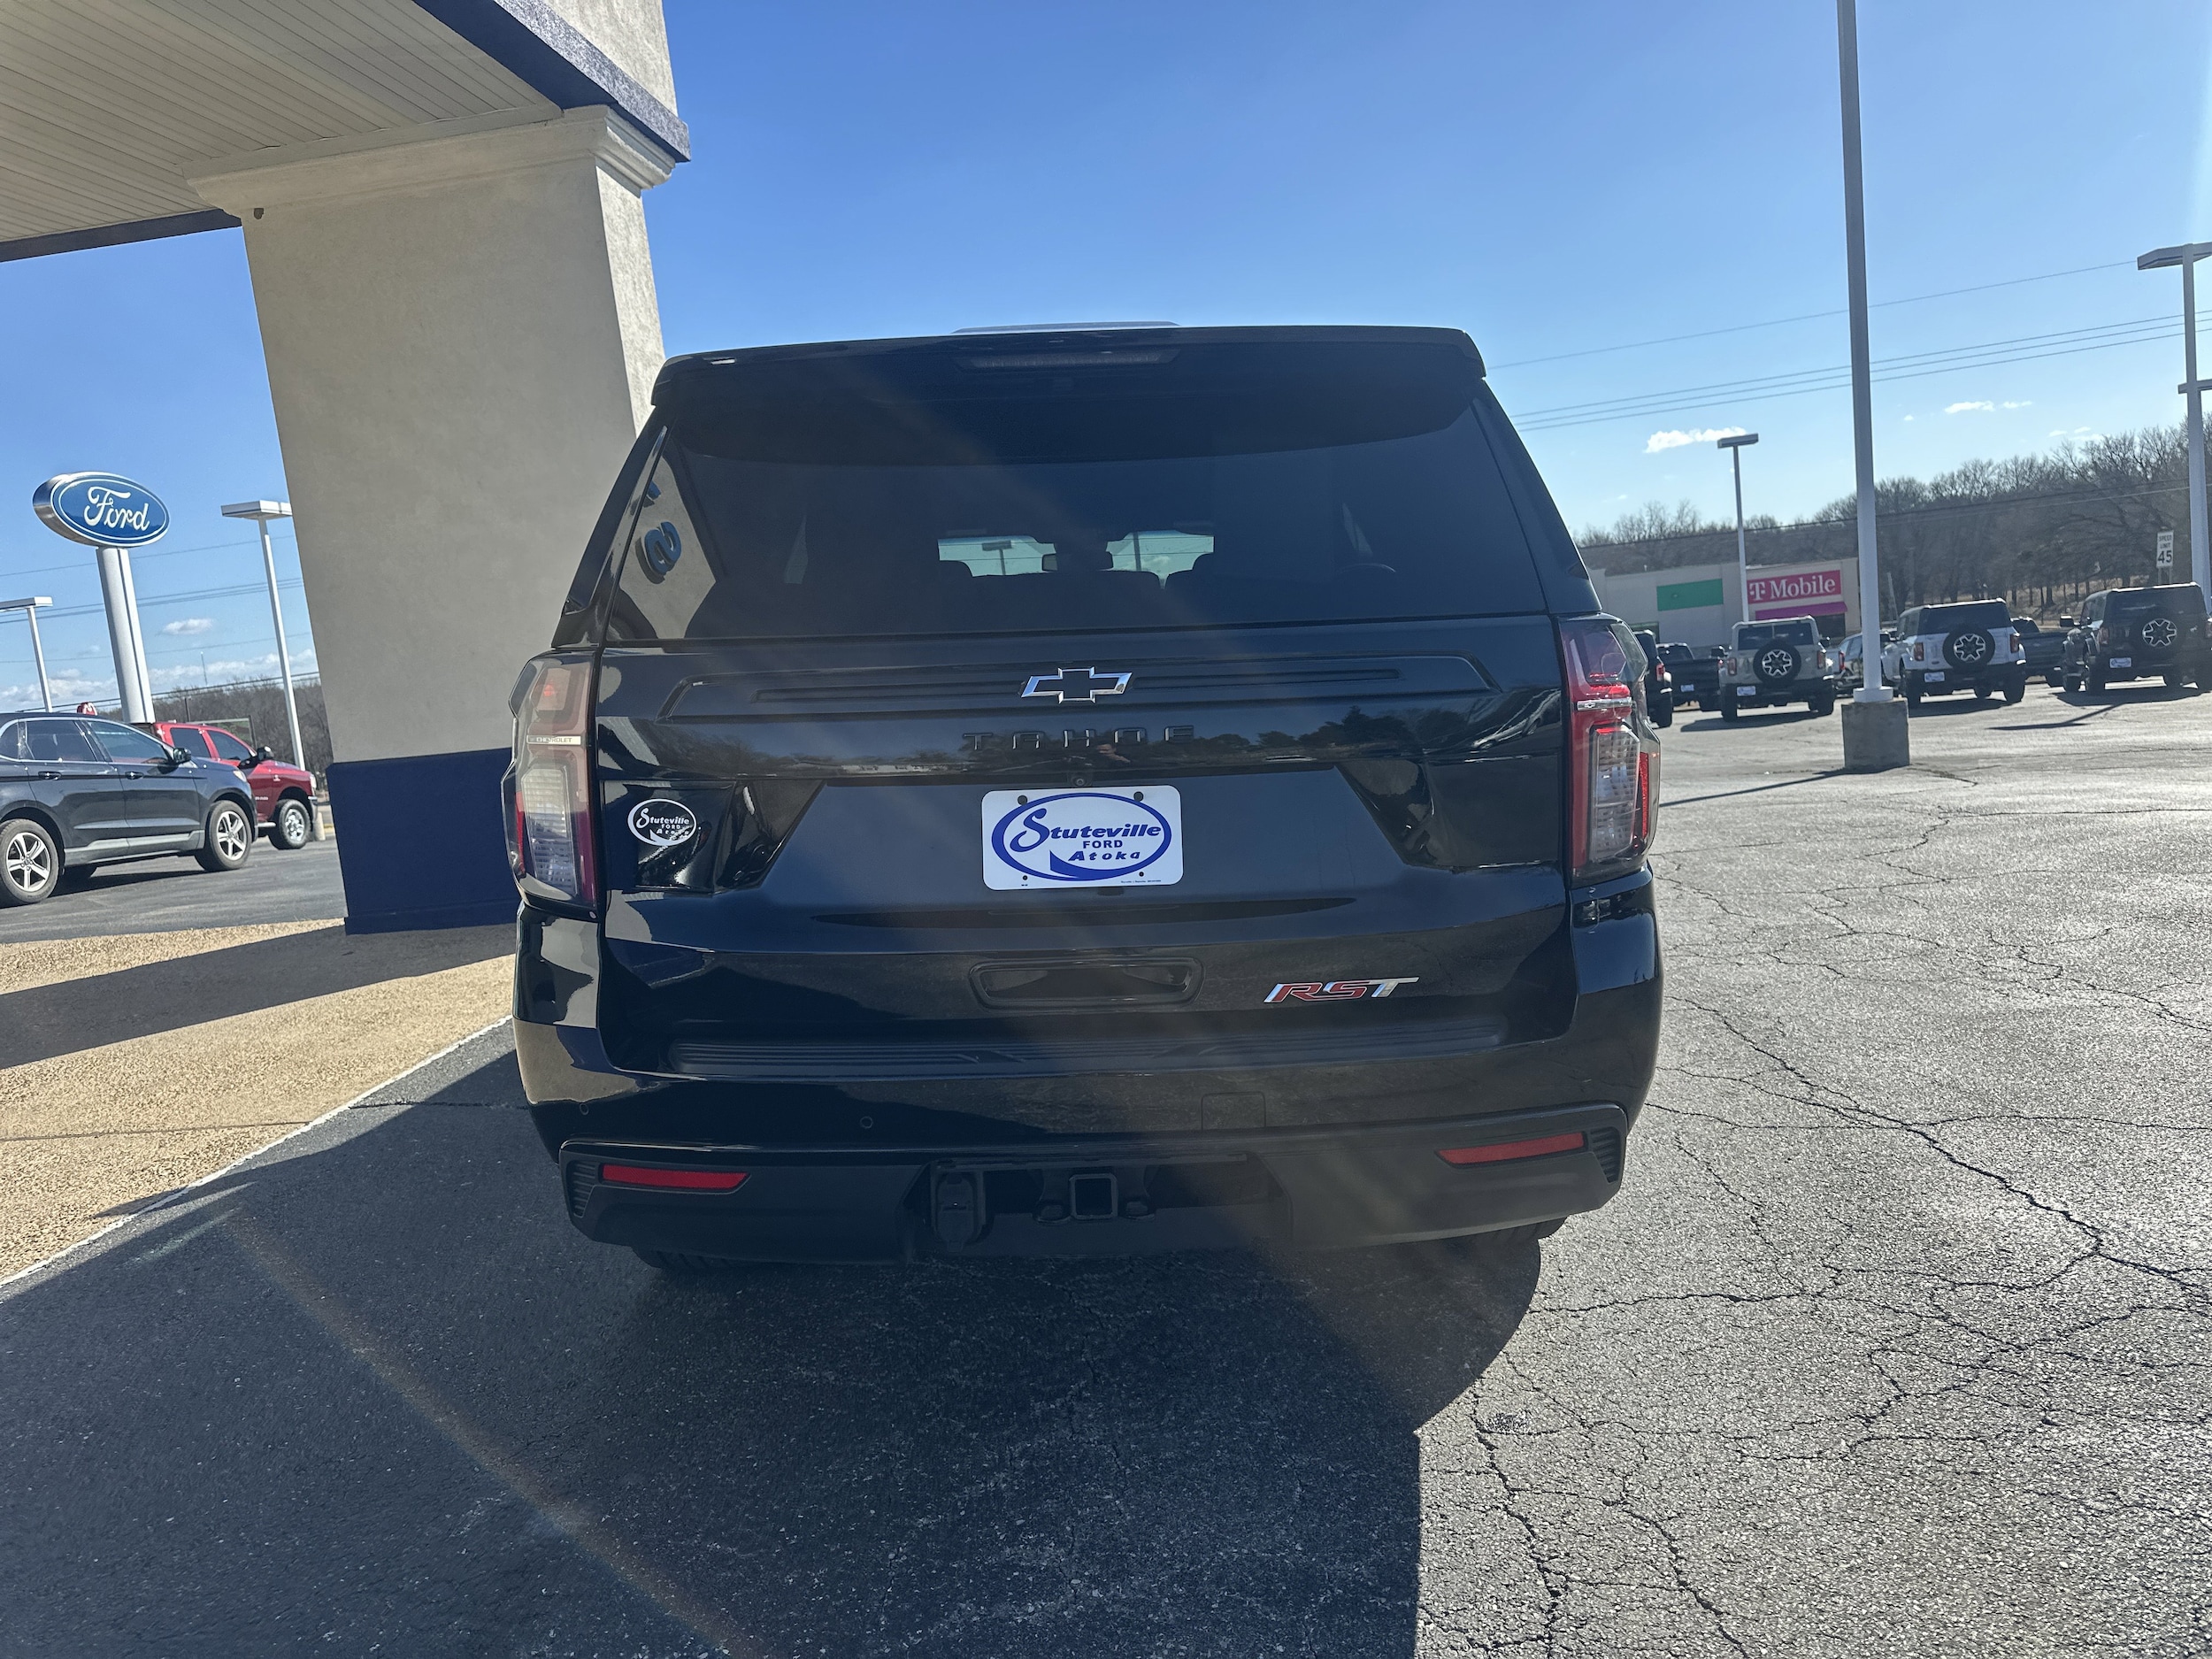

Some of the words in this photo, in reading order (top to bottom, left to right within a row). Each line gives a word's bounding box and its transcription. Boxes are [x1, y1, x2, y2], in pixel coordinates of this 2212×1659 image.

[84, 486, 150, 531] Ford
[2158, 549, 2172, 564] 45
[1769, 574, 1836, 600] Mobile
[963, 725, 1194, 750] TAHOE
[635, 807, 690, 829] Stuteville
[1010, 808, 1162, 853] Stuteville
[1068, 850, 1141, 862] Atoka
[1082, 840, 1123, 849] FORD
[1263, 976, 1420, 1003] RST
